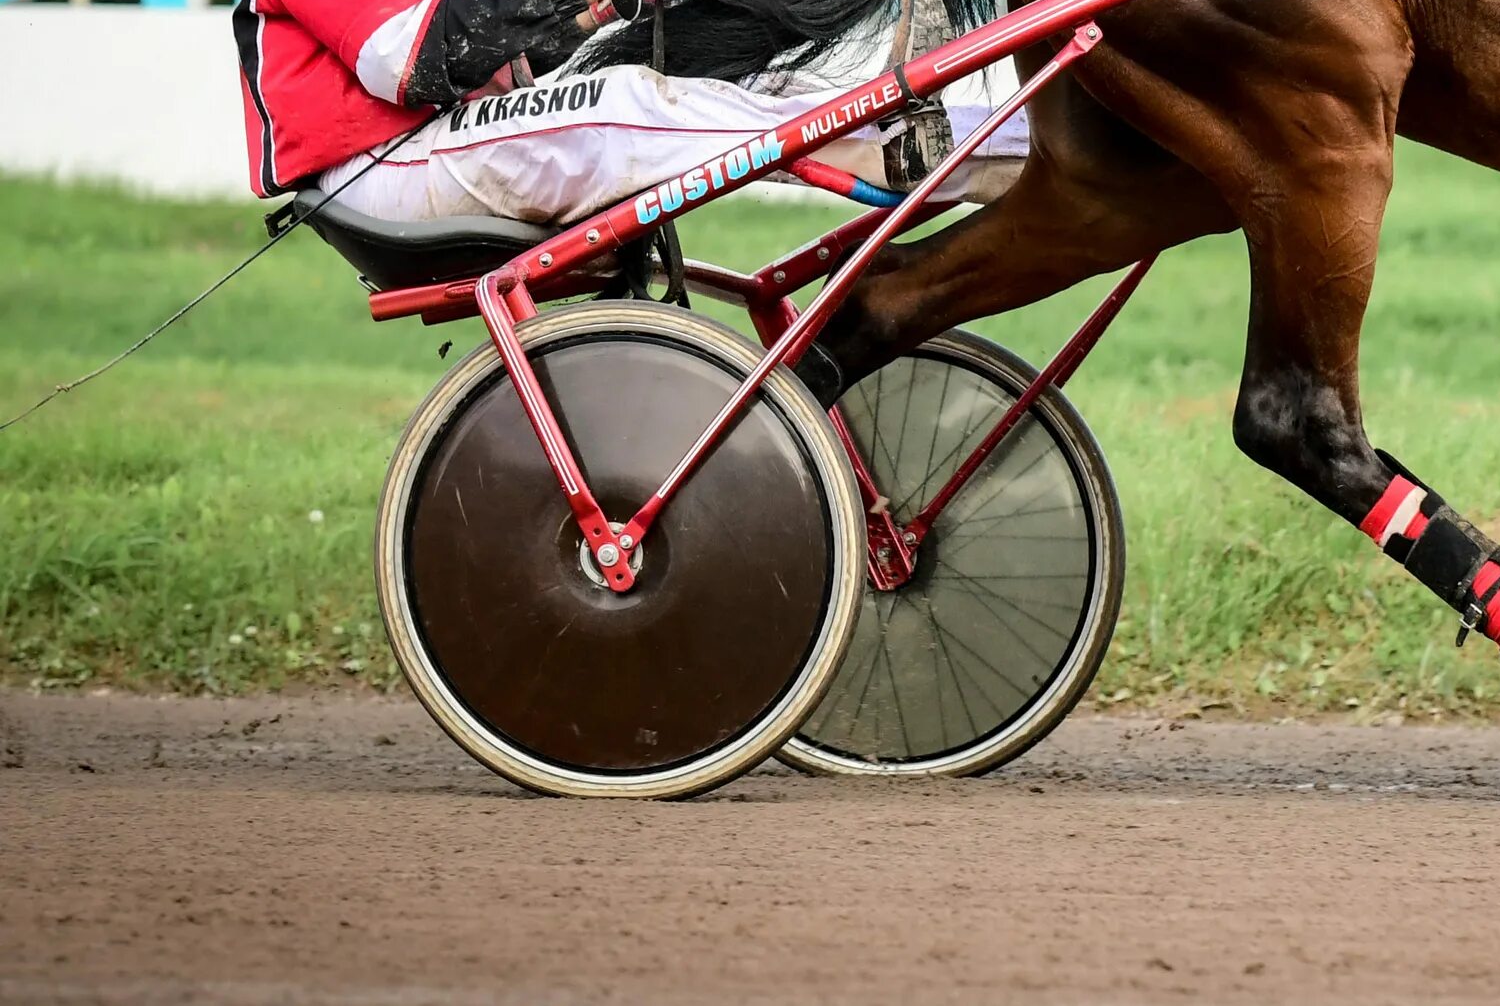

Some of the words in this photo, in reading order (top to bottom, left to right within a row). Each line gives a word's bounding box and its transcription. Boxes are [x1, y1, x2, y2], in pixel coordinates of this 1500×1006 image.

[450, 105, 468, 132] V.
[475, 77, 607, 127] KRASNOV
[634, 131, 788, 225] CUSTOM
